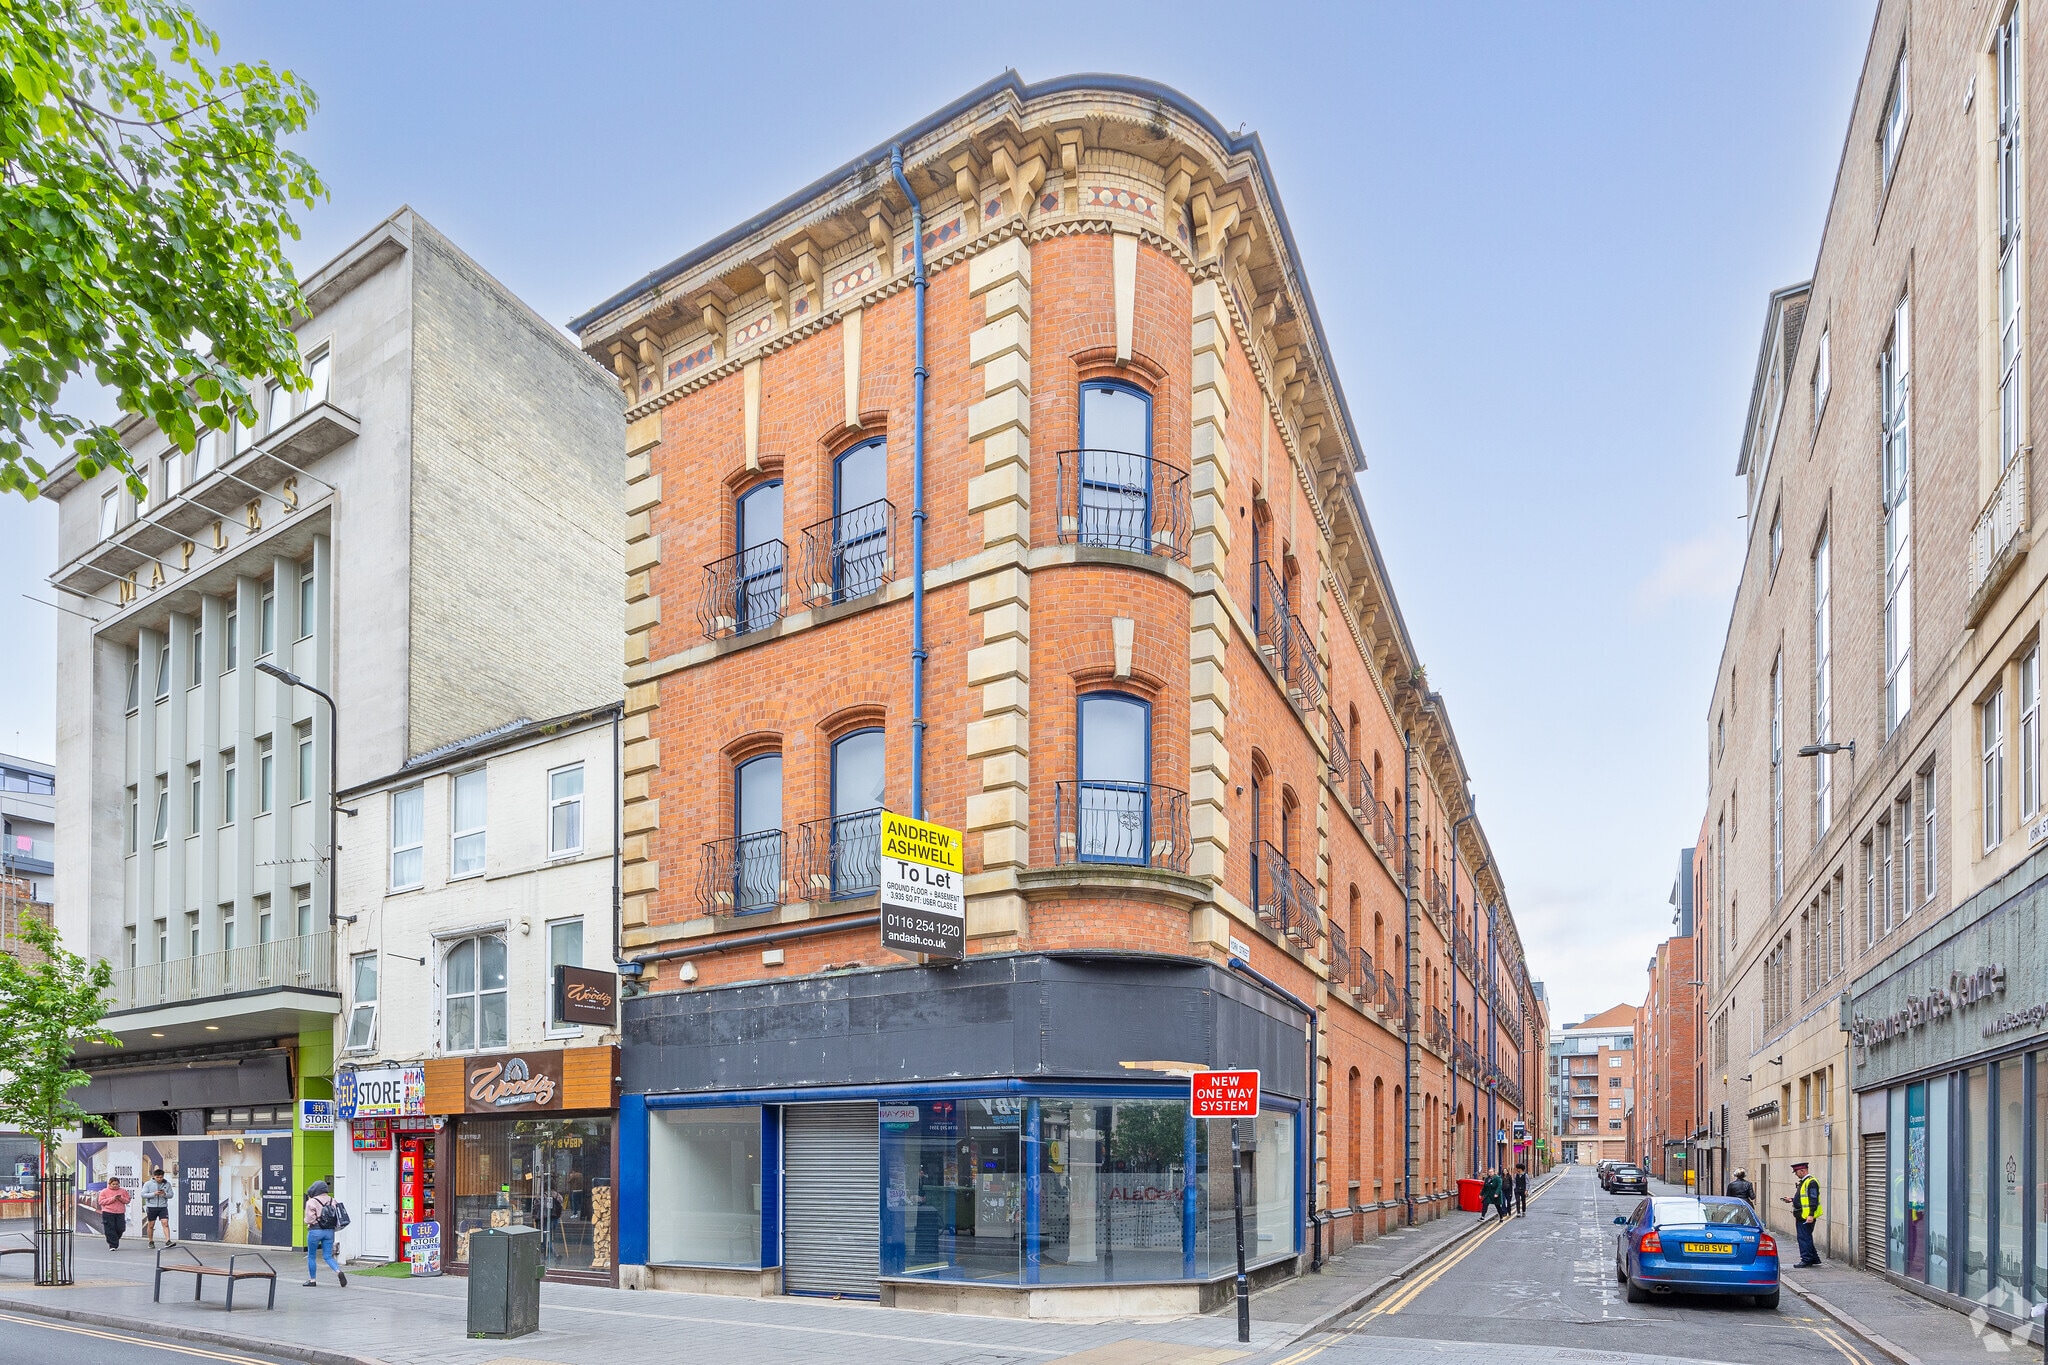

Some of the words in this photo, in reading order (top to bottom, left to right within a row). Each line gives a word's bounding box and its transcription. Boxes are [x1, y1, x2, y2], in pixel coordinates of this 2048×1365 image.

[119, 476, 299, 608] MAPLES
[887, 820, 950, 848] ANDREW
[887, 838, 955, 867] ASHWELL
[897, 861, 920, 882] To
[926, 867, 951, 890] Let
[886, 881, 910, 894] GROUND
[910, 886, 928, 897] FLOOR
[934, 890, 960, 903] BASEMENT
[905, 893, 914, 903] SQ
[922, 897, 936, 907] USER
[936, 900, 953, 910] CLASS
[953, 903, 957, 911] E
[887, 913, 914, 929] 0116
[916, 918, 934, 934] 254
[936, 922, 960, 938] 1220
[888, 930, 947, 949] andash.co.uk
[1950, 962, 2006, 1010] Centre
[567, 983, 612, 1007] Woodiz
[470, 1062, 556, 1105] Woodiz
[1211, 1076, 1240, 1087] NEW
[342, 1085, 353, 1107] EU
[358, 1081, 401, 1106] STORE
[1196, 1088, 1223, 1099] ONE
[1227, 1088, 1254, 1099] WAY
[1200, 1100, 1248, 1111] SYSTEM
[305, 1114, 333, 1124] STORE
[115, 1166, 133, 1176] STUDIOS
[187, 1168, 210, 1179] BECAUSE
[190, 1180, 207, 1191] EVERY
[188, 1192, 211, 1204] STUDENT
[185, 1205, 191, 1216] IS
[191, 1205, 214, 1217] BESPOKE
[419, 1226, 430, 1235] EU
[413, 1237, 440, 1246] STORE
[1687, 1244, 1710, 1252] LT08
[1712, 1244, 1729, 1253] SVC
